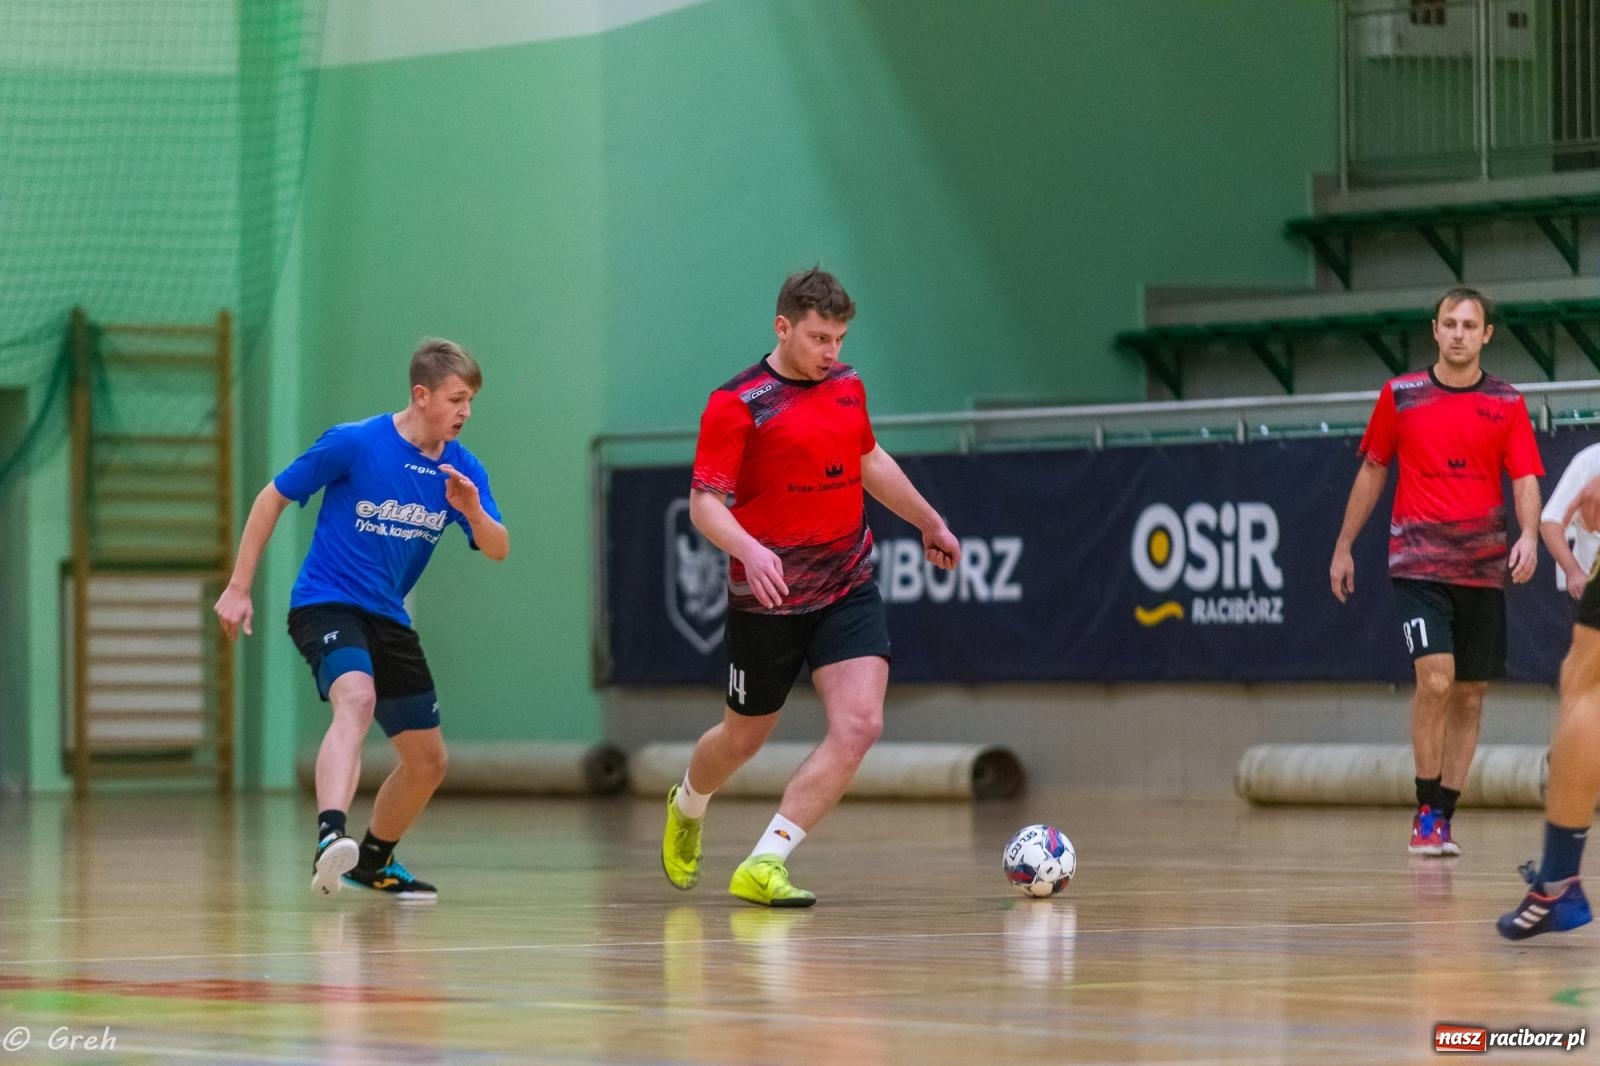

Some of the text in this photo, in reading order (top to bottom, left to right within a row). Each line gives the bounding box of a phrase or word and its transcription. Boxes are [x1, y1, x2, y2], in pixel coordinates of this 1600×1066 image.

[404, 463, 437, 475] regio
[1403, 617, 1429, 654] 87
[729, 663, 747, 705] 14
[1009, 830, 1038, 861] SELECT
